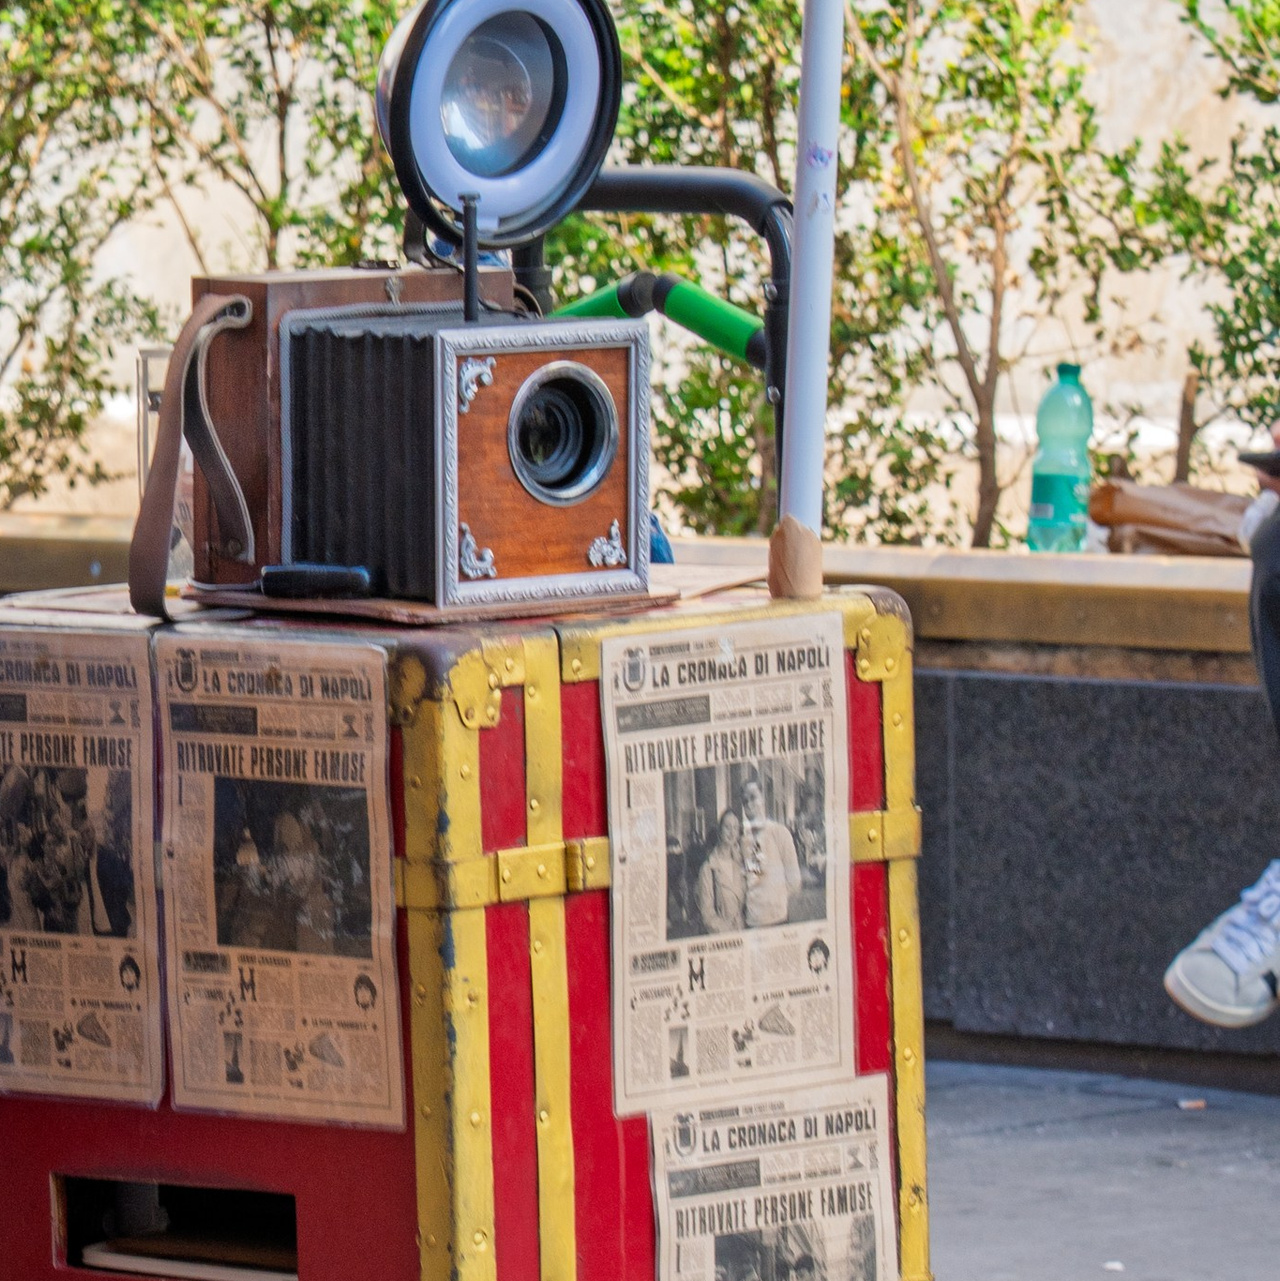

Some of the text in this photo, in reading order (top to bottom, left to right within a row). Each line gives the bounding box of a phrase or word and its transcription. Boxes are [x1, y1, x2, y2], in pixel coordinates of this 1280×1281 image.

[66, 661, 81, 686] DI
[86, 663, 138, 688] NAPOLI
[203, 670, 220, 693] LA
[299, 675, 314, 697] DI
[321, 676, 372, 701] NAPOLI
[652, 665, 670, 688] LA
[754, 653, 769, 675] DI
[776, 647, 829, 671] NAPOLI
[20, 733, 76, 765] PERSONE
[83, 736, 132, 767] FAMOSE
[177, 741, 365, 782] RITROVATE PERSONE FAMOSE
[624, 719, 825, 774] RITROVATE PERSONE FAMOSE
[10, 949, 28, 983] M
[238, 967, 257, 1001] M
[688, 956, 705, 992] M
[702, 1108, 876, 1152] LA CRONACA DI NAPOLI
[675, 1181, 873, 1239] RITROVATE PERSONE FAMOSE
